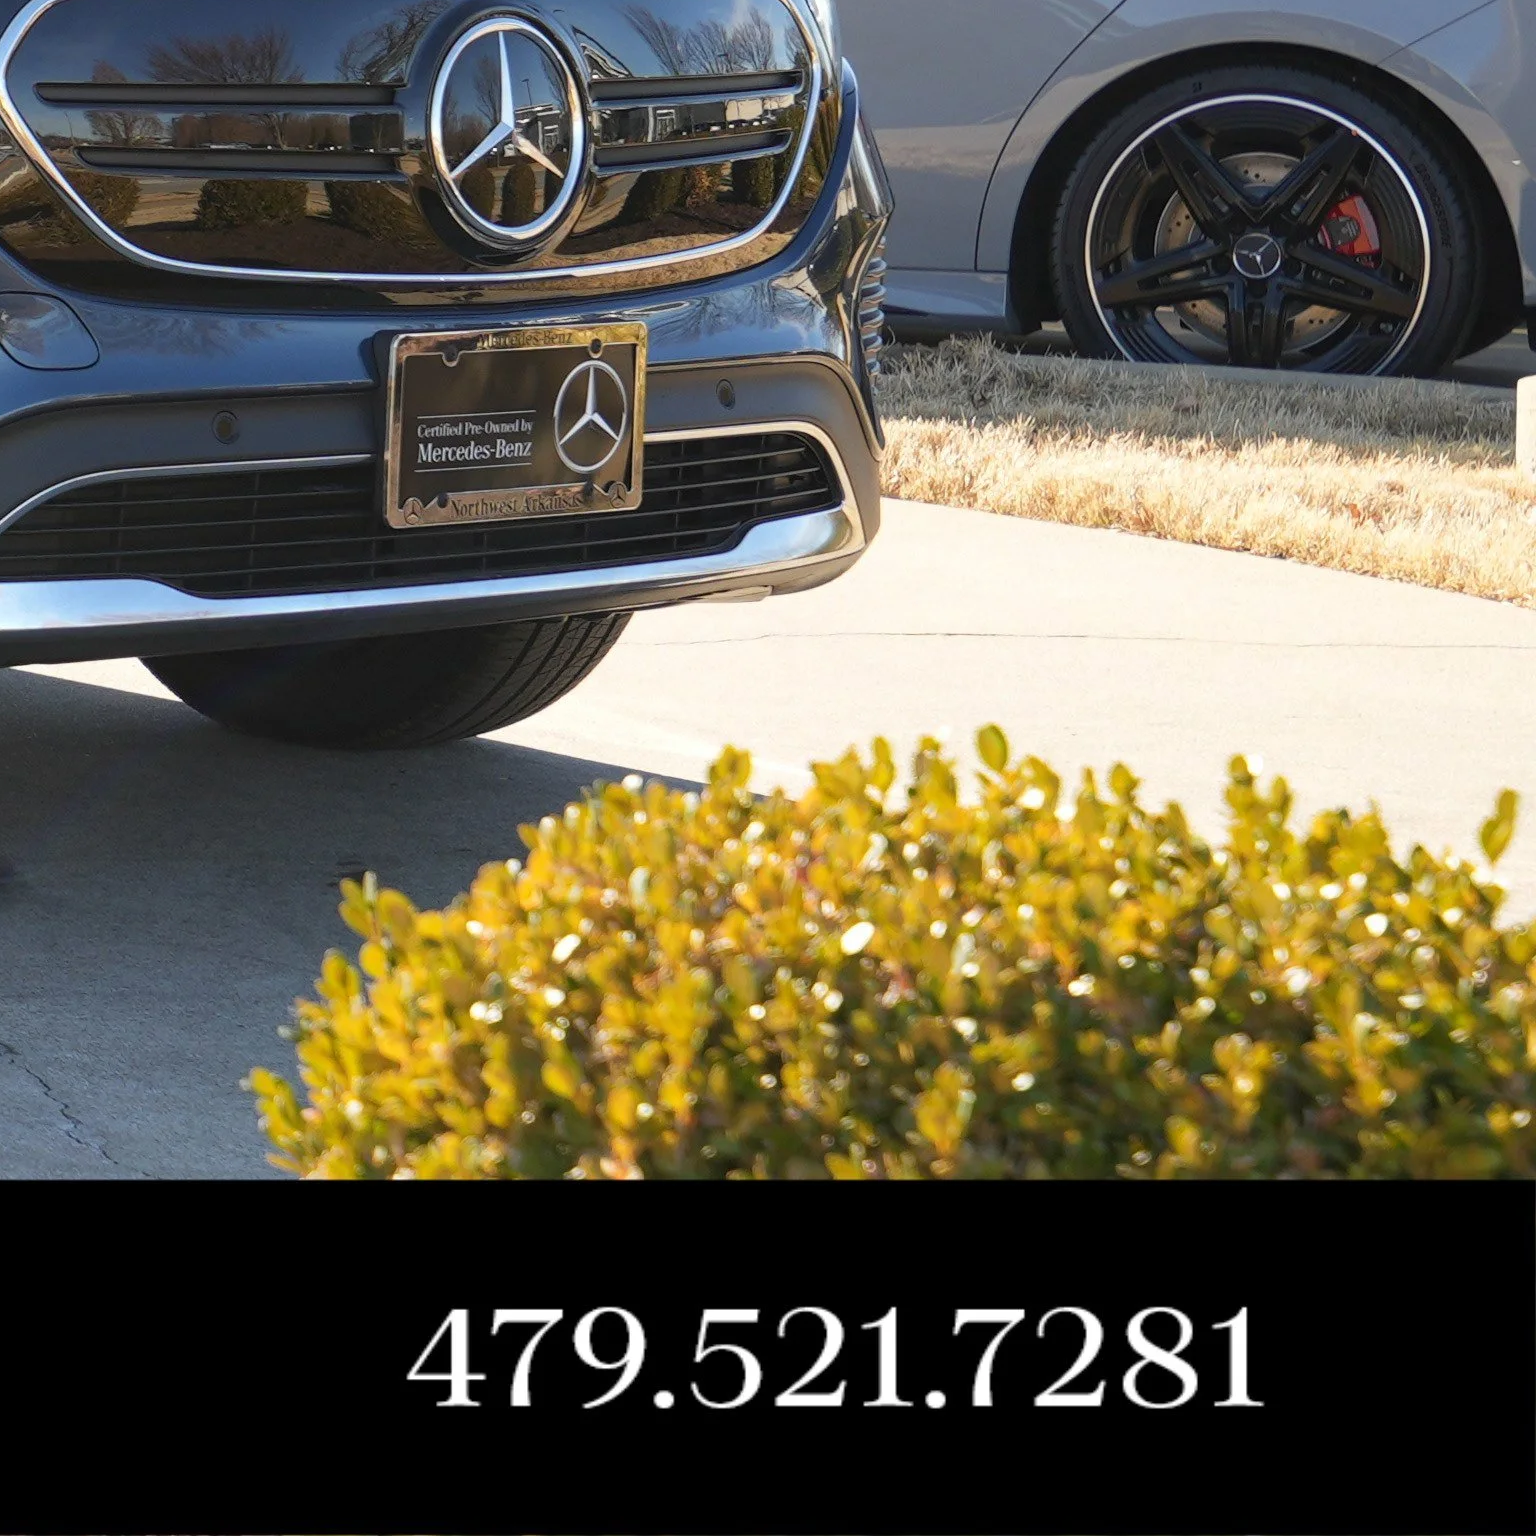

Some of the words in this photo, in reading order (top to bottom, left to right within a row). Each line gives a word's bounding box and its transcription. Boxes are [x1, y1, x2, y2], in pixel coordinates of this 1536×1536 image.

[477, 330, 573, 350] Mercedes-Benz
[417, 422, 462, 438] Certified
[464, 419, 519, 435] Pre-Owned
[521, 418, 533, 434] by
[417, 438, 533, 463] Mercedes-Benz
[450, 496, 519, 518] Northwest
